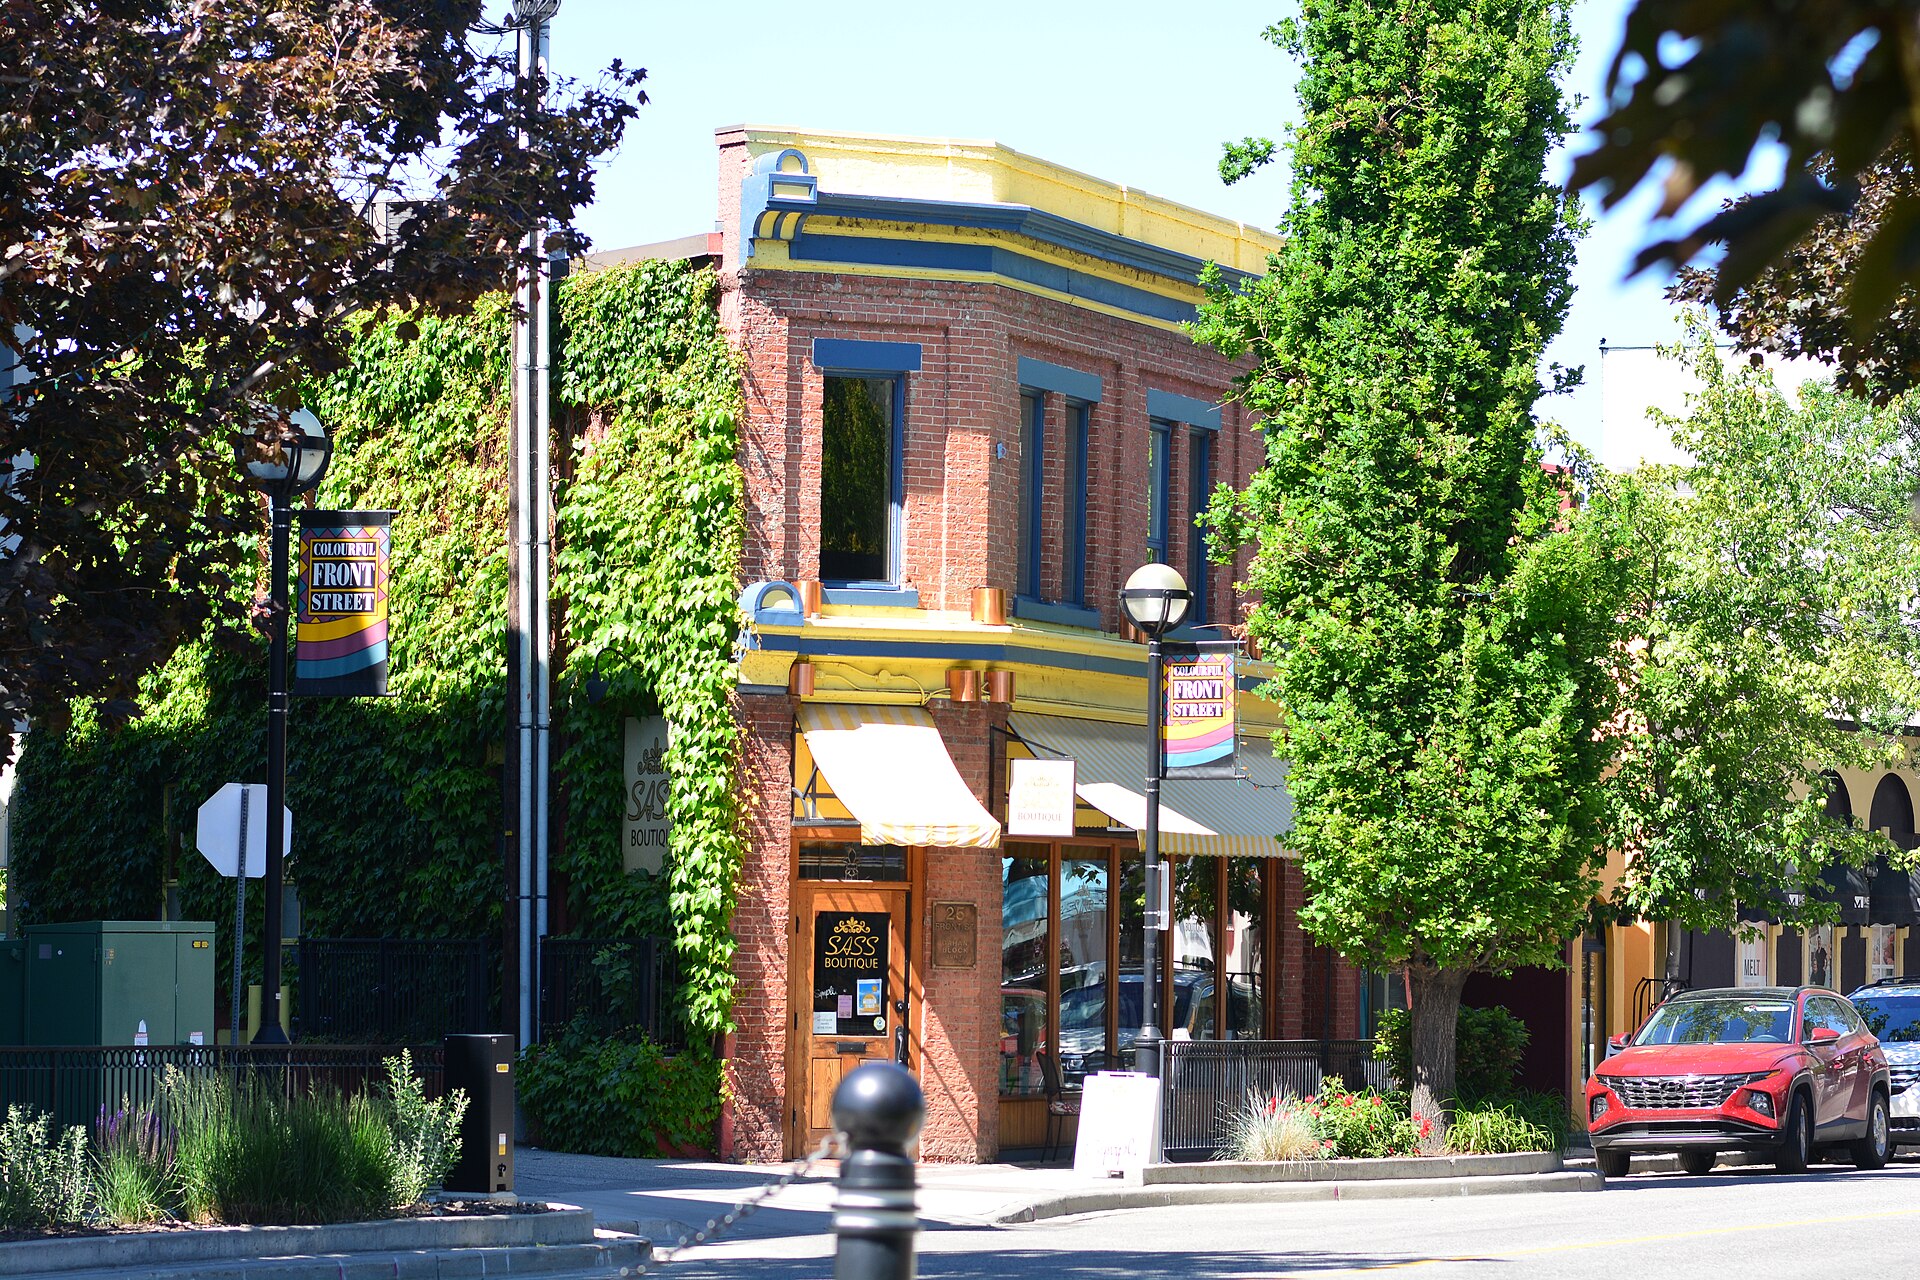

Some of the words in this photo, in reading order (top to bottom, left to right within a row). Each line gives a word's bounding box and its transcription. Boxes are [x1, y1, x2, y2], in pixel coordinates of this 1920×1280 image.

[313, 542, 376, 556] COLOURFUL
[312, 562, 375, 587] FRONT
[311, 593, 375, 611] STREET
[1173, 665, 1223, 677] COLOURFUL
[1173, 680, 1223, 699] FRONT
[1173, 703, 1223, 717] STREET
[627, 780, 671, 822] SAS
[1017, 812, 1062, 822] BOUTIQUE
[631, 829, 669, 847] BOUTIQ
[946, 906, 965, 920] 25
[935, 922, 961, 931] FRONT
[825, 936, 879, 956] SASS
[824, 957, 879, 970] BOUTIQUE
[1744, 959, 1760, 976] MELT
